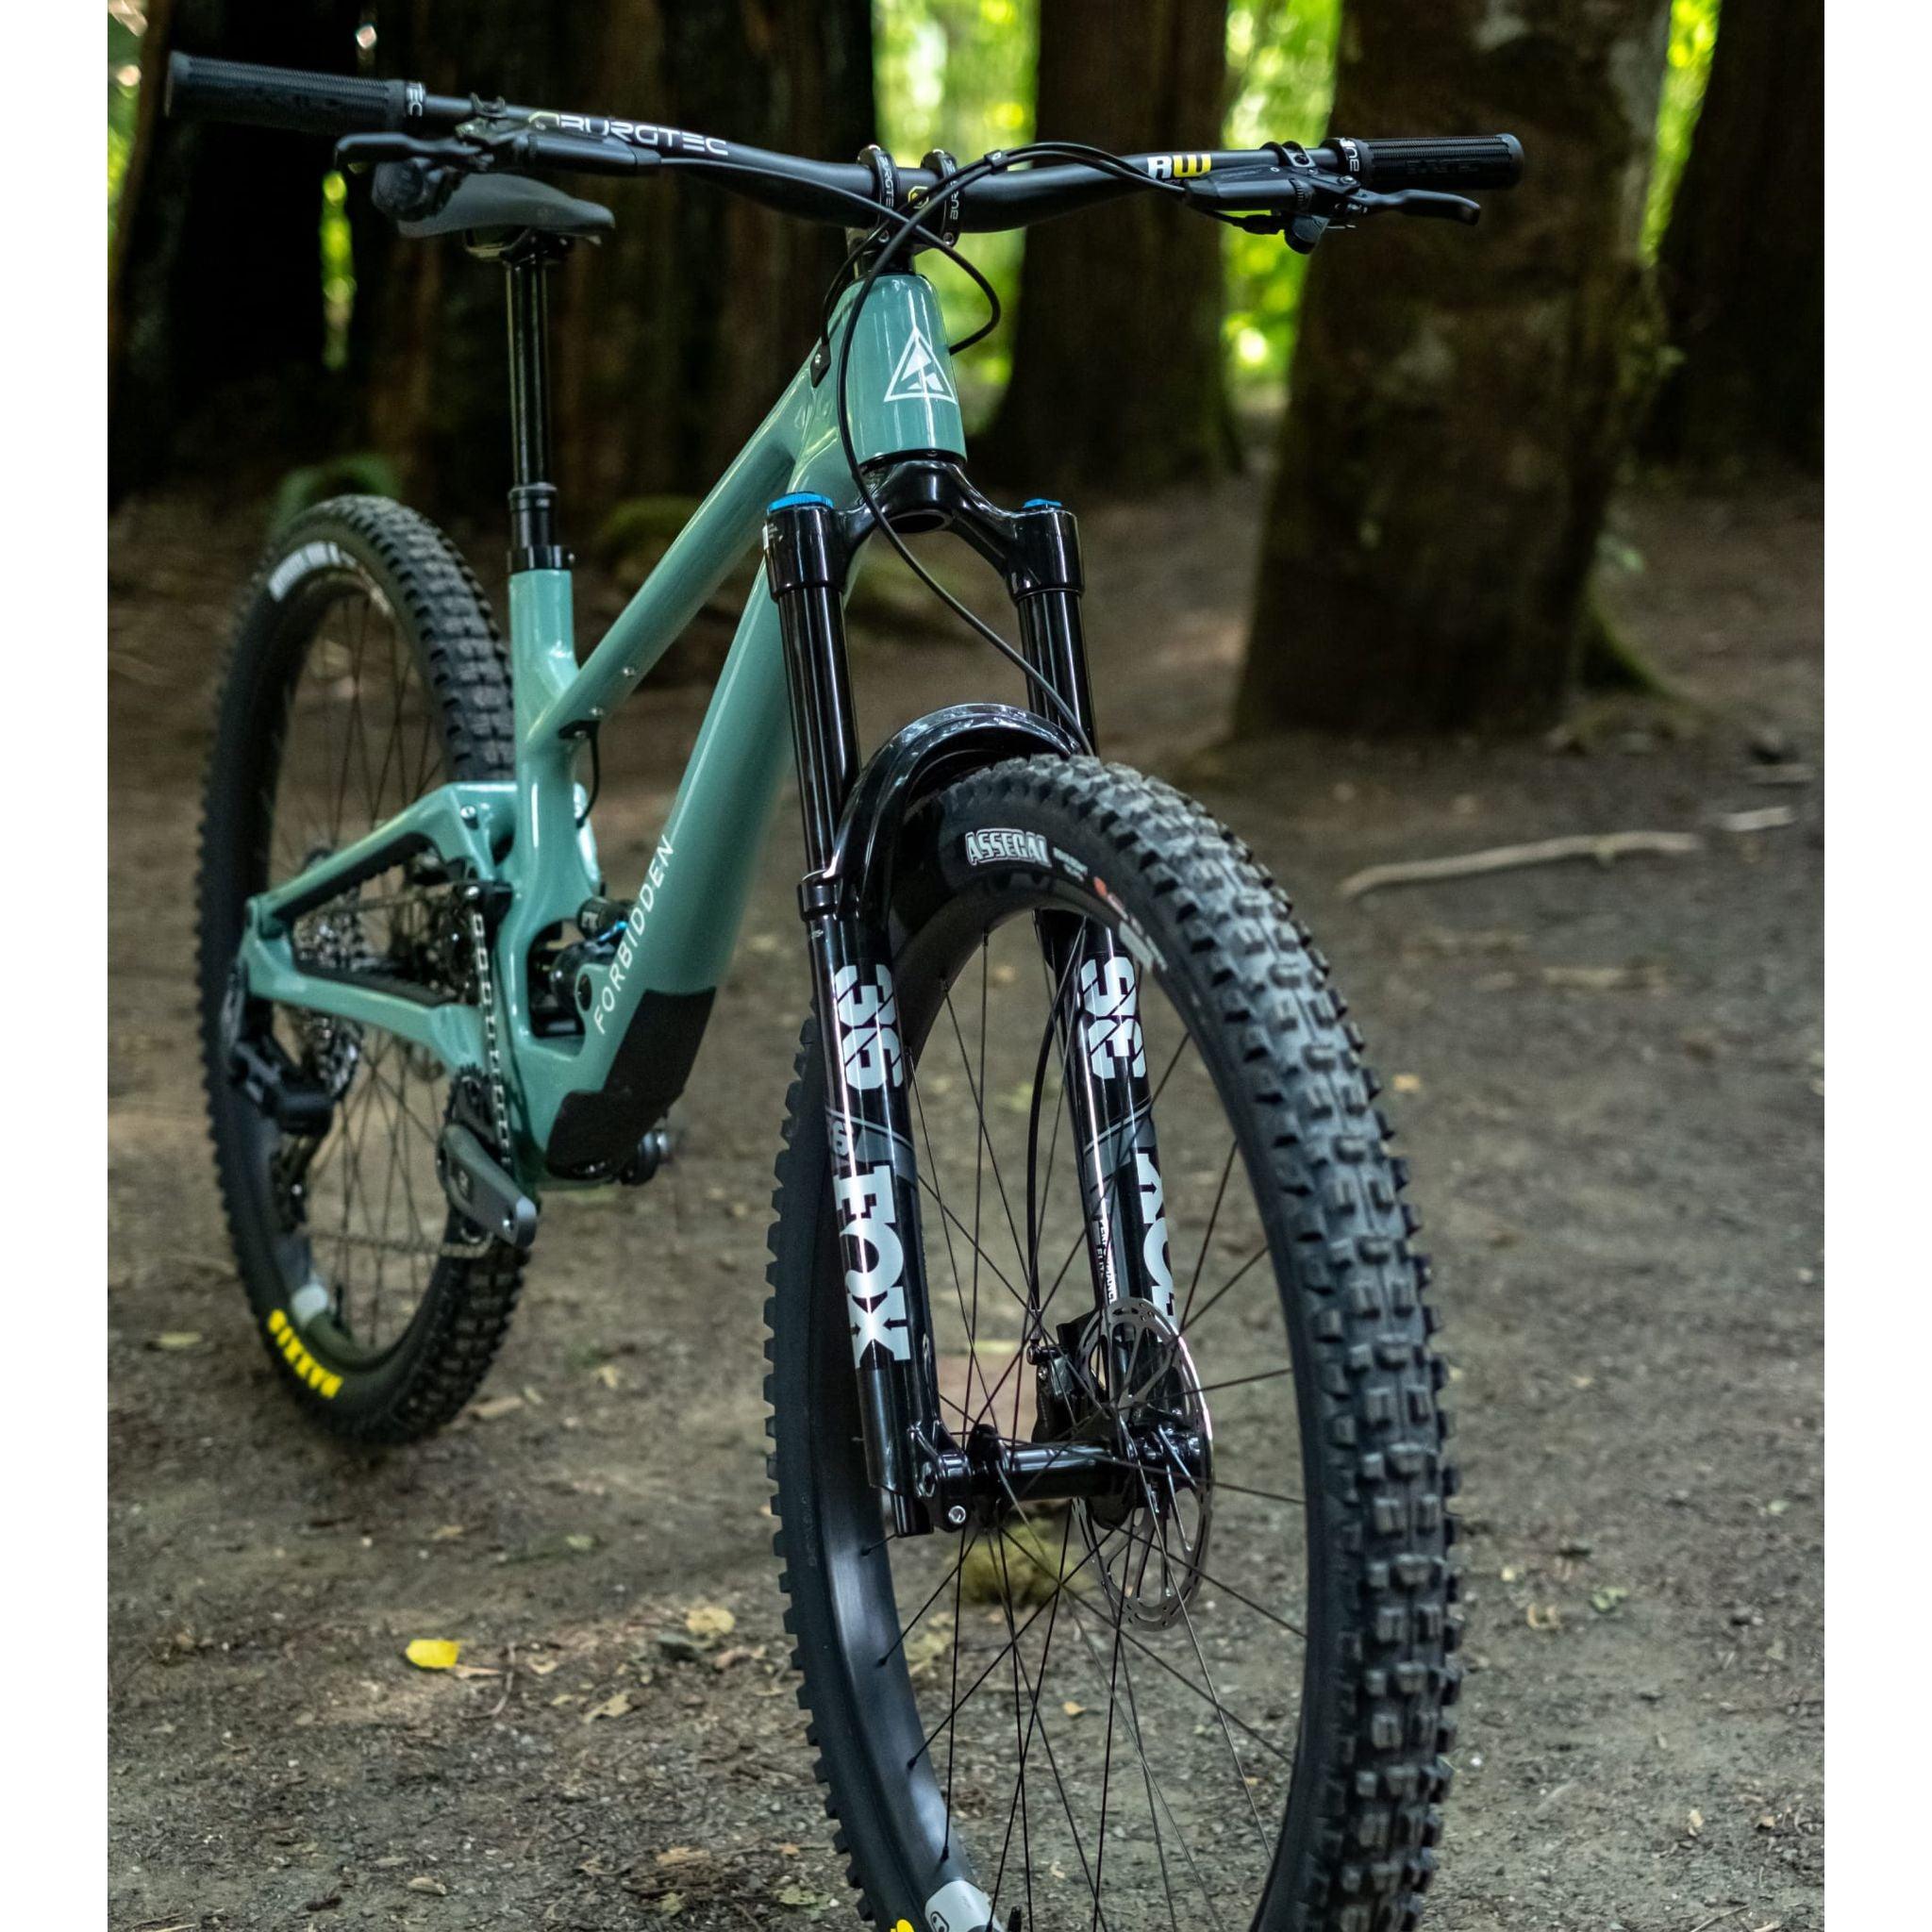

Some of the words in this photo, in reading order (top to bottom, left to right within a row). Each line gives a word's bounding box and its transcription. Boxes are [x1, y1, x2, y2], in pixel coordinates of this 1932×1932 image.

[560, 113, 728, 157] BURGTEC
[965, 827, 1053, 866] ASSEGAI
[593, 834, 674, 1035] FORBIDDEN
[833, 963, 905, 1091] 36
[1079, 955, 1147, 1080] 36
[832, 1164, 912, 1369] FOX
